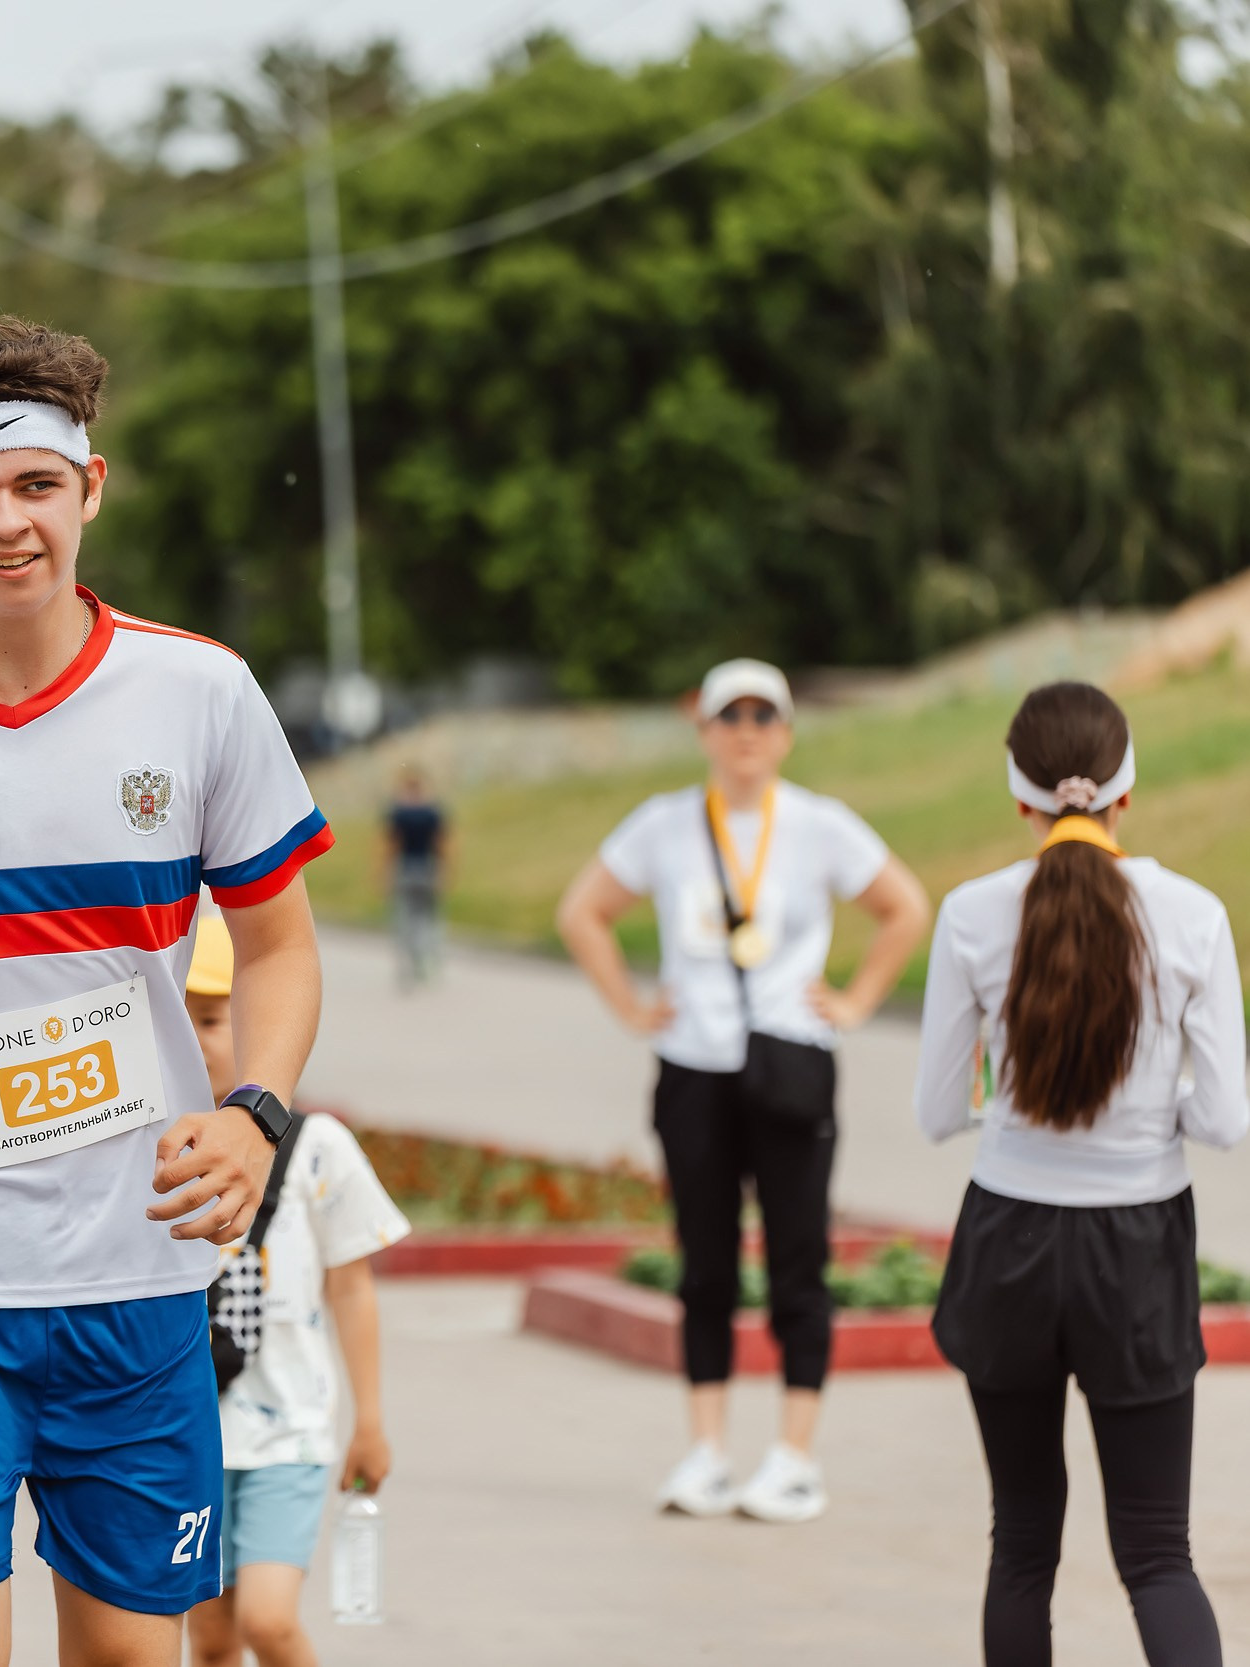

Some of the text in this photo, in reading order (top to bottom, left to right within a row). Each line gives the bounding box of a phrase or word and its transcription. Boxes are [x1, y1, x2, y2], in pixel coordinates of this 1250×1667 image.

[72, 1002, 131, 1033] D'ORO
[11, 1053, 106, 1118] 253
[114, 1098, 145, 1118] ЗАБЕГ
[171, 1505, 211, 1564] 27
